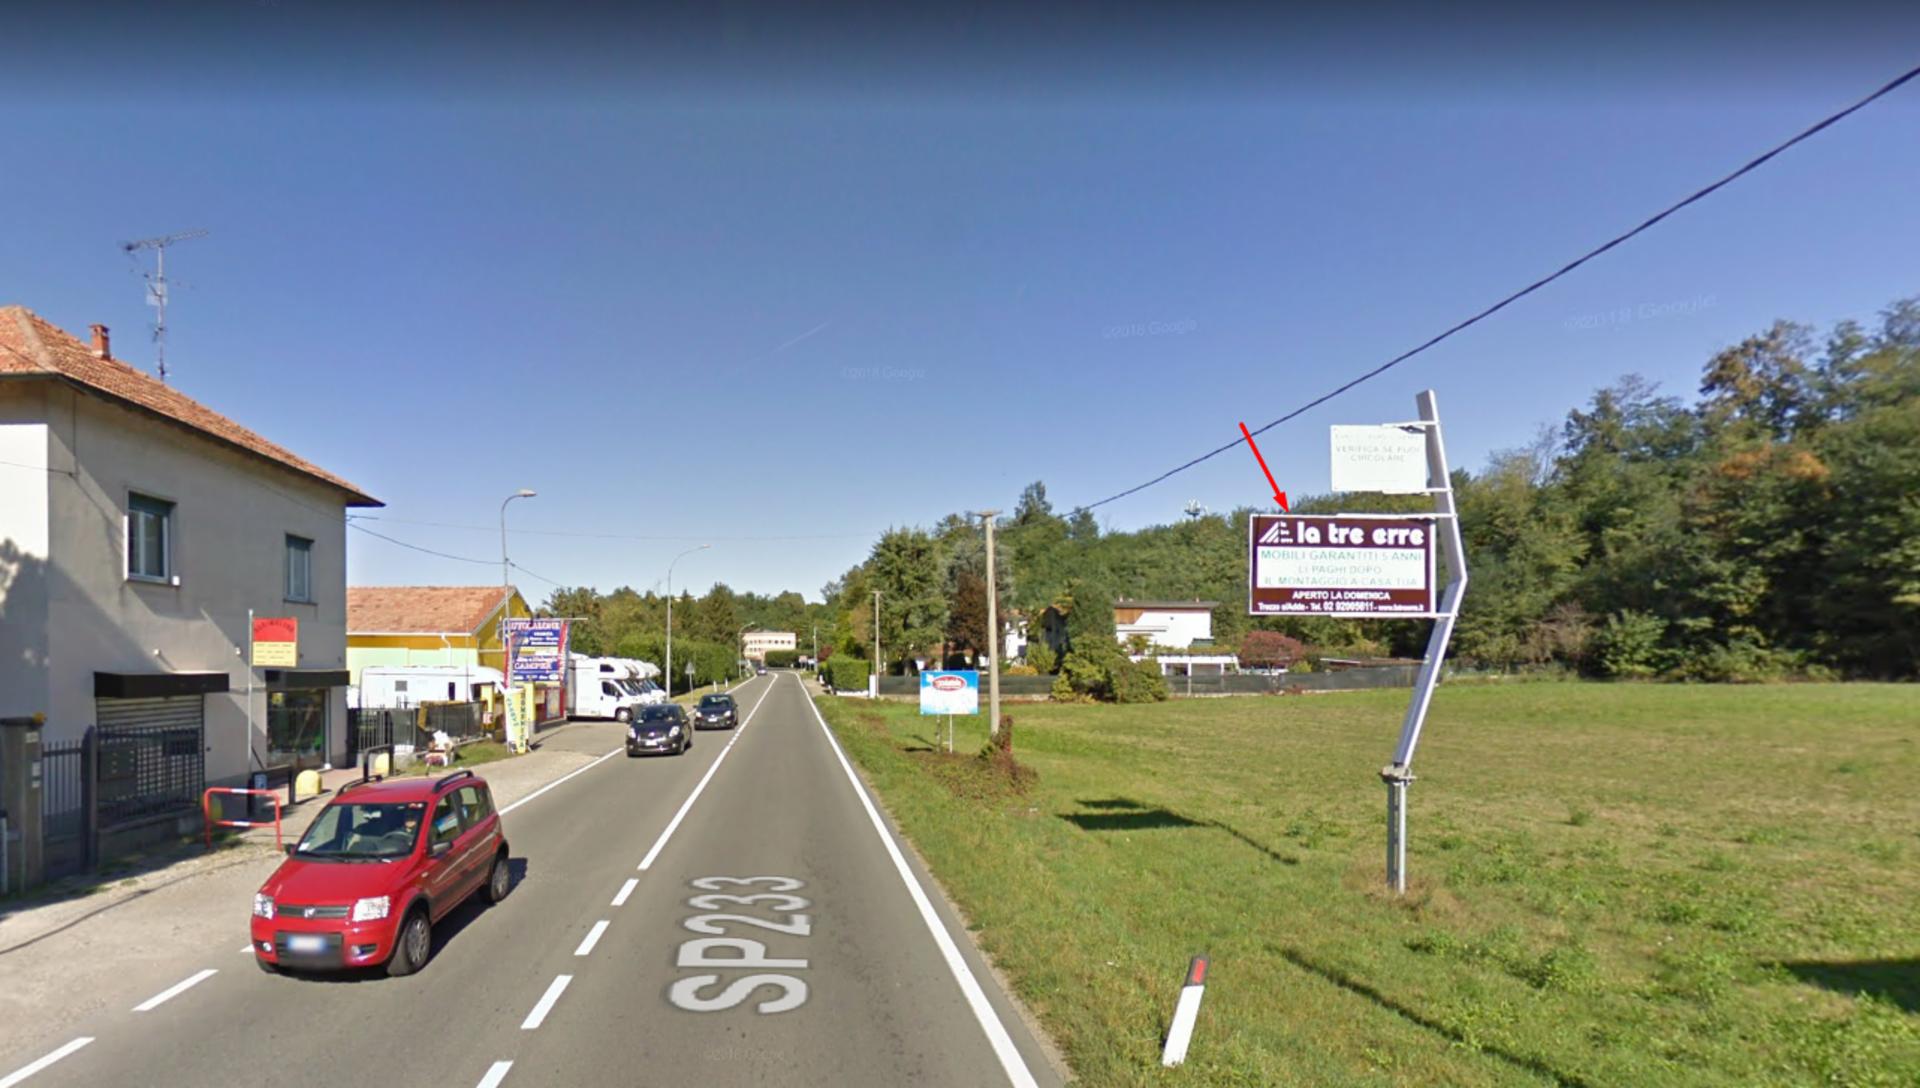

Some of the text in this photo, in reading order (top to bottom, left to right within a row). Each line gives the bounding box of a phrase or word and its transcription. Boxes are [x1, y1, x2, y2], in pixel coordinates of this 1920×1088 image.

[1296, 521, 1425, 546] la tre erre
[1261, 550, 1306, 560] MOBILI
[1310, 550, 1378, 561] GARANTITI
[1392, 552, 1422, 561] ANNI
[1312, 565, 1346, 574] PAGHI
[1349, 565, 1382, 574] DOPO
[1278, 576, 1347, 586] MONTAGGIO
[1350, 576, 1358, 586] A
[1361, 577, 1392, 586] CASA
[1396, 577, 1418, 586] TUA
[1292, 591, 1391, 600] APERTO LA DOMENICA
[1323, 601, 1334, 611] 02
